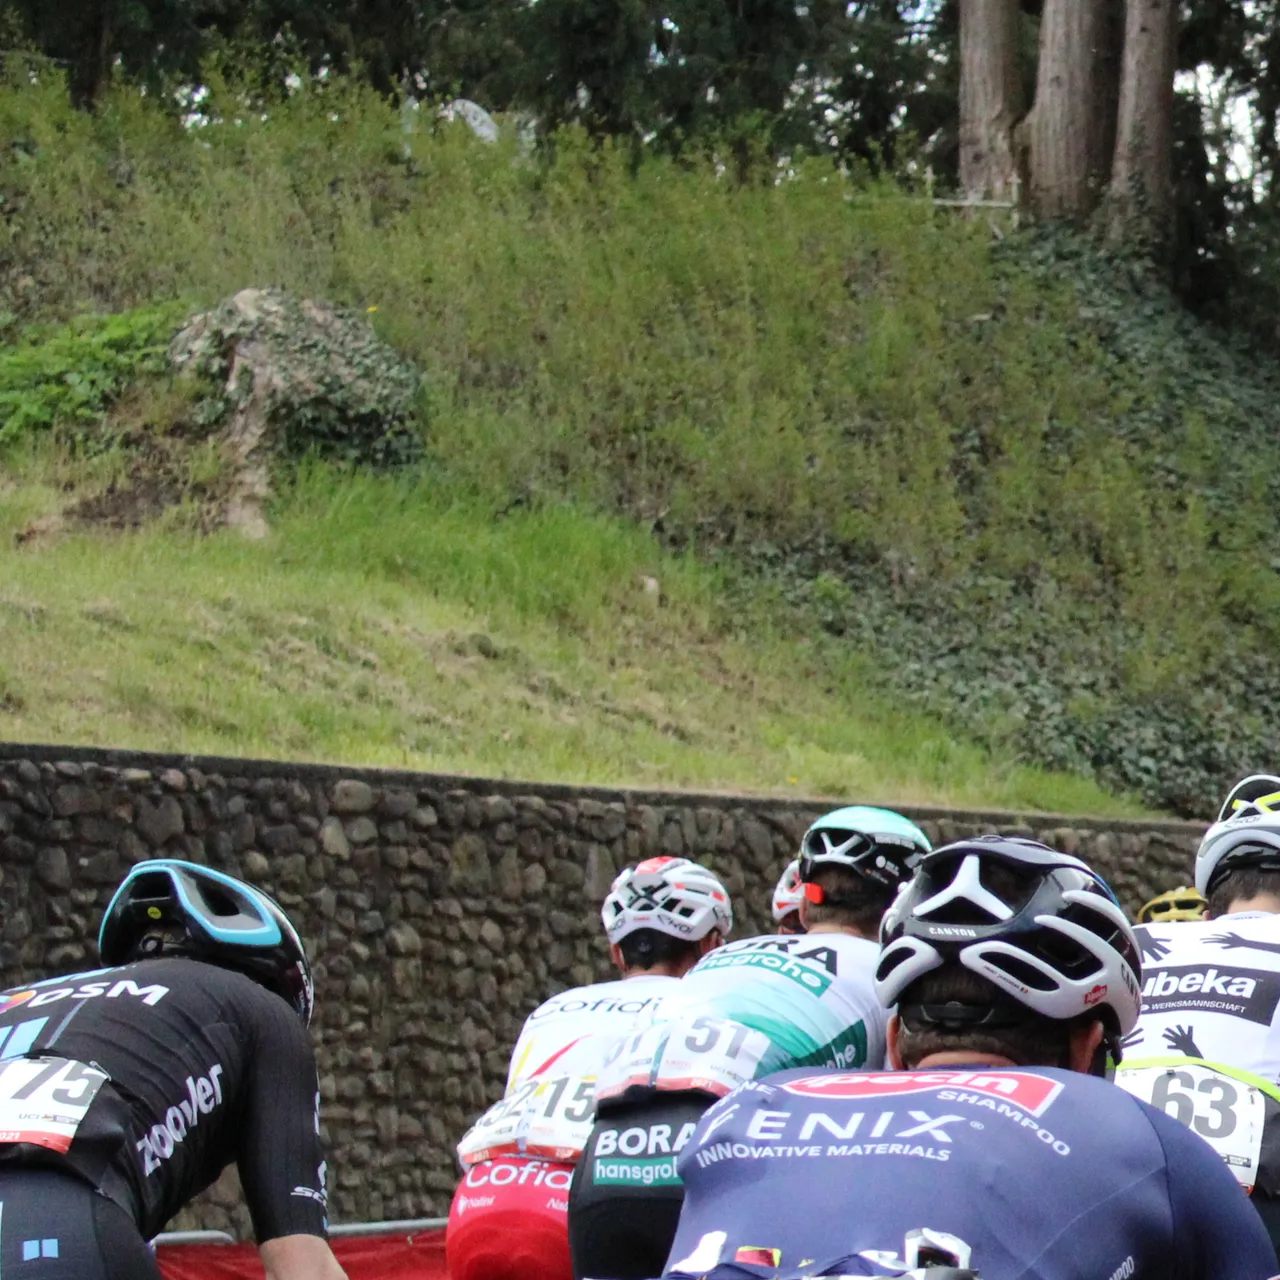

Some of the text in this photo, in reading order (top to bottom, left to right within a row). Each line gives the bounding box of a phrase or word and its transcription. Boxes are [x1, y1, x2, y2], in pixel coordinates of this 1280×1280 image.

[929, 926, 976, 938] CANYON
[28, 980, 170, 1006] DSM
[1151, 1000, 1247, 1013] WERKSMANNSCHAFT
[684, 1011, 747, 1059] 51
[136, 1063, 223, 1178] zoover
[1150, 1070, 1239, 1139] 63
[594, 1122, 697, 1157] BORA
[936, 1089, 1072, 1157] SHAMPOO
[696, 1142, 951, 1168] INNOVATIVE MATERIALS
